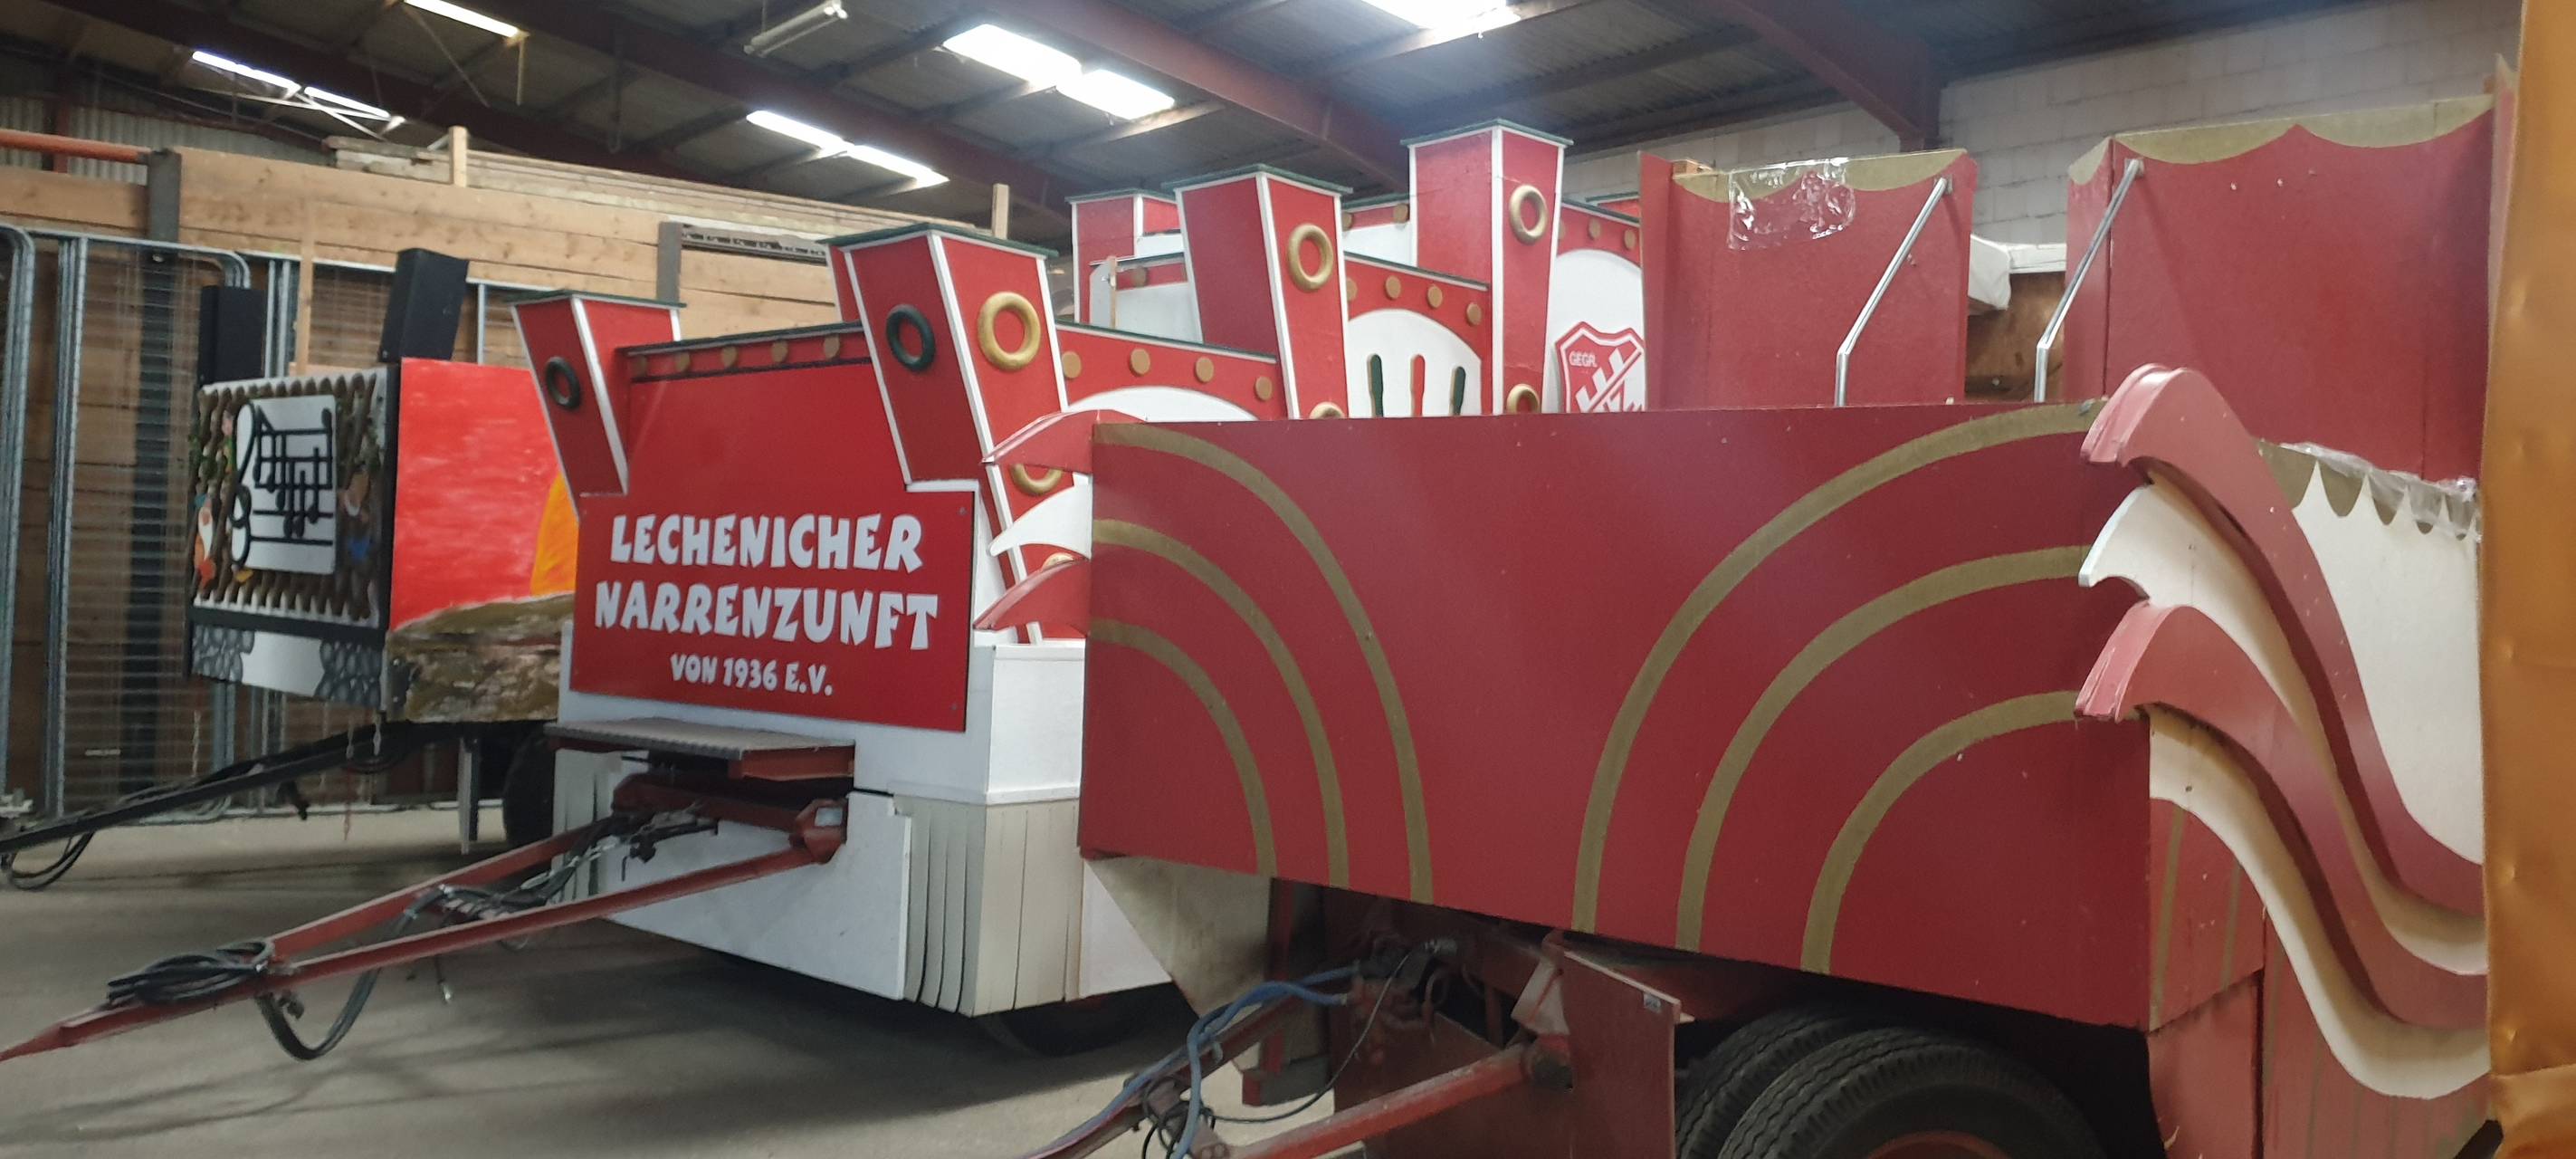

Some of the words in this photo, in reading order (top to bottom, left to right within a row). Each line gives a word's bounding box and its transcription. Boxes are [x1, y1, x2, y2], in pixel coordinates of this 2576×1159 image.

[610, 513, 923, 573] LECHENICHER
[595, 580, 939, 650] NARRENZUNFT
[670, 654, 718, 684] VON
[722, 657, 778, 691] 1936
[785, 662, 833, 696] E.V.
